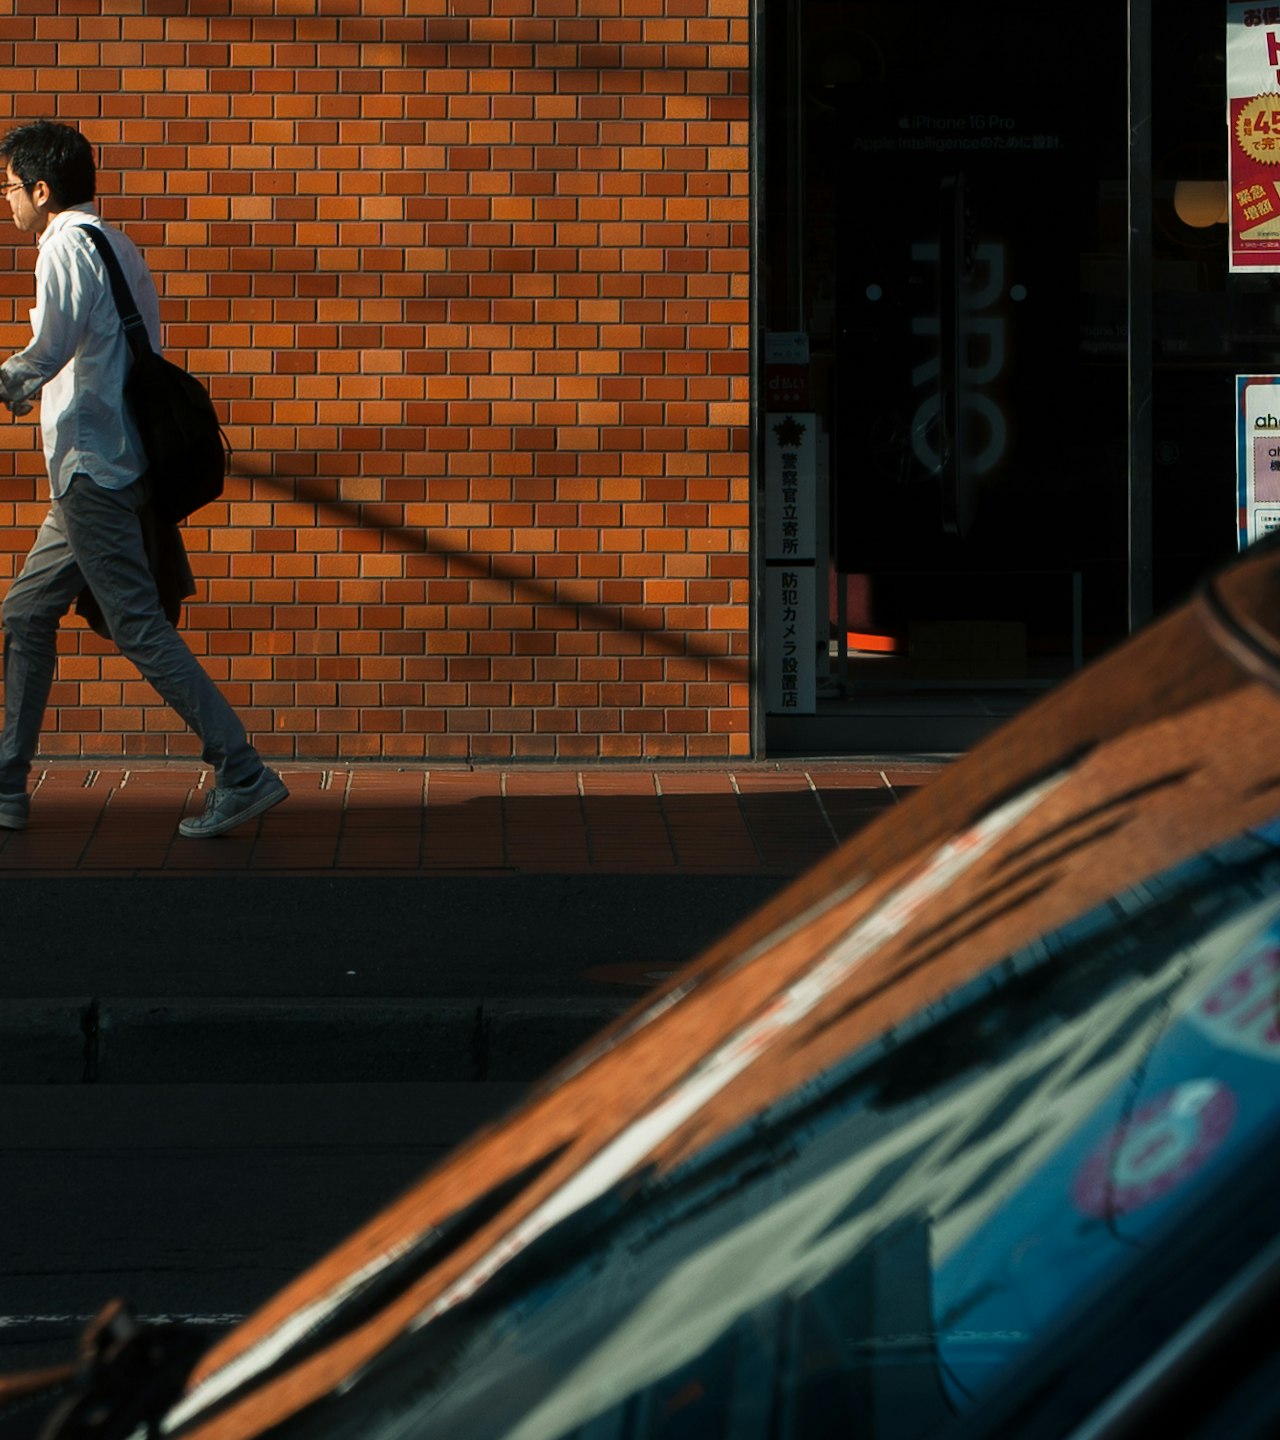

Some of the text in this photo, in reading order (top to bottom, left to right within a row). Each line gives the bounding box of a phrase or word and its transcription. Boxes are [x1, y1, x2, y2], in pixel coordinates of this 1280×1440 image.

[911, 114, 966, 129] iPhone
[988, 114, 1016, 129] Pro
[781, 452, 799, 555] 警察官立寄所
[781, 572, 799, 708] 防犯カメラ設置店
